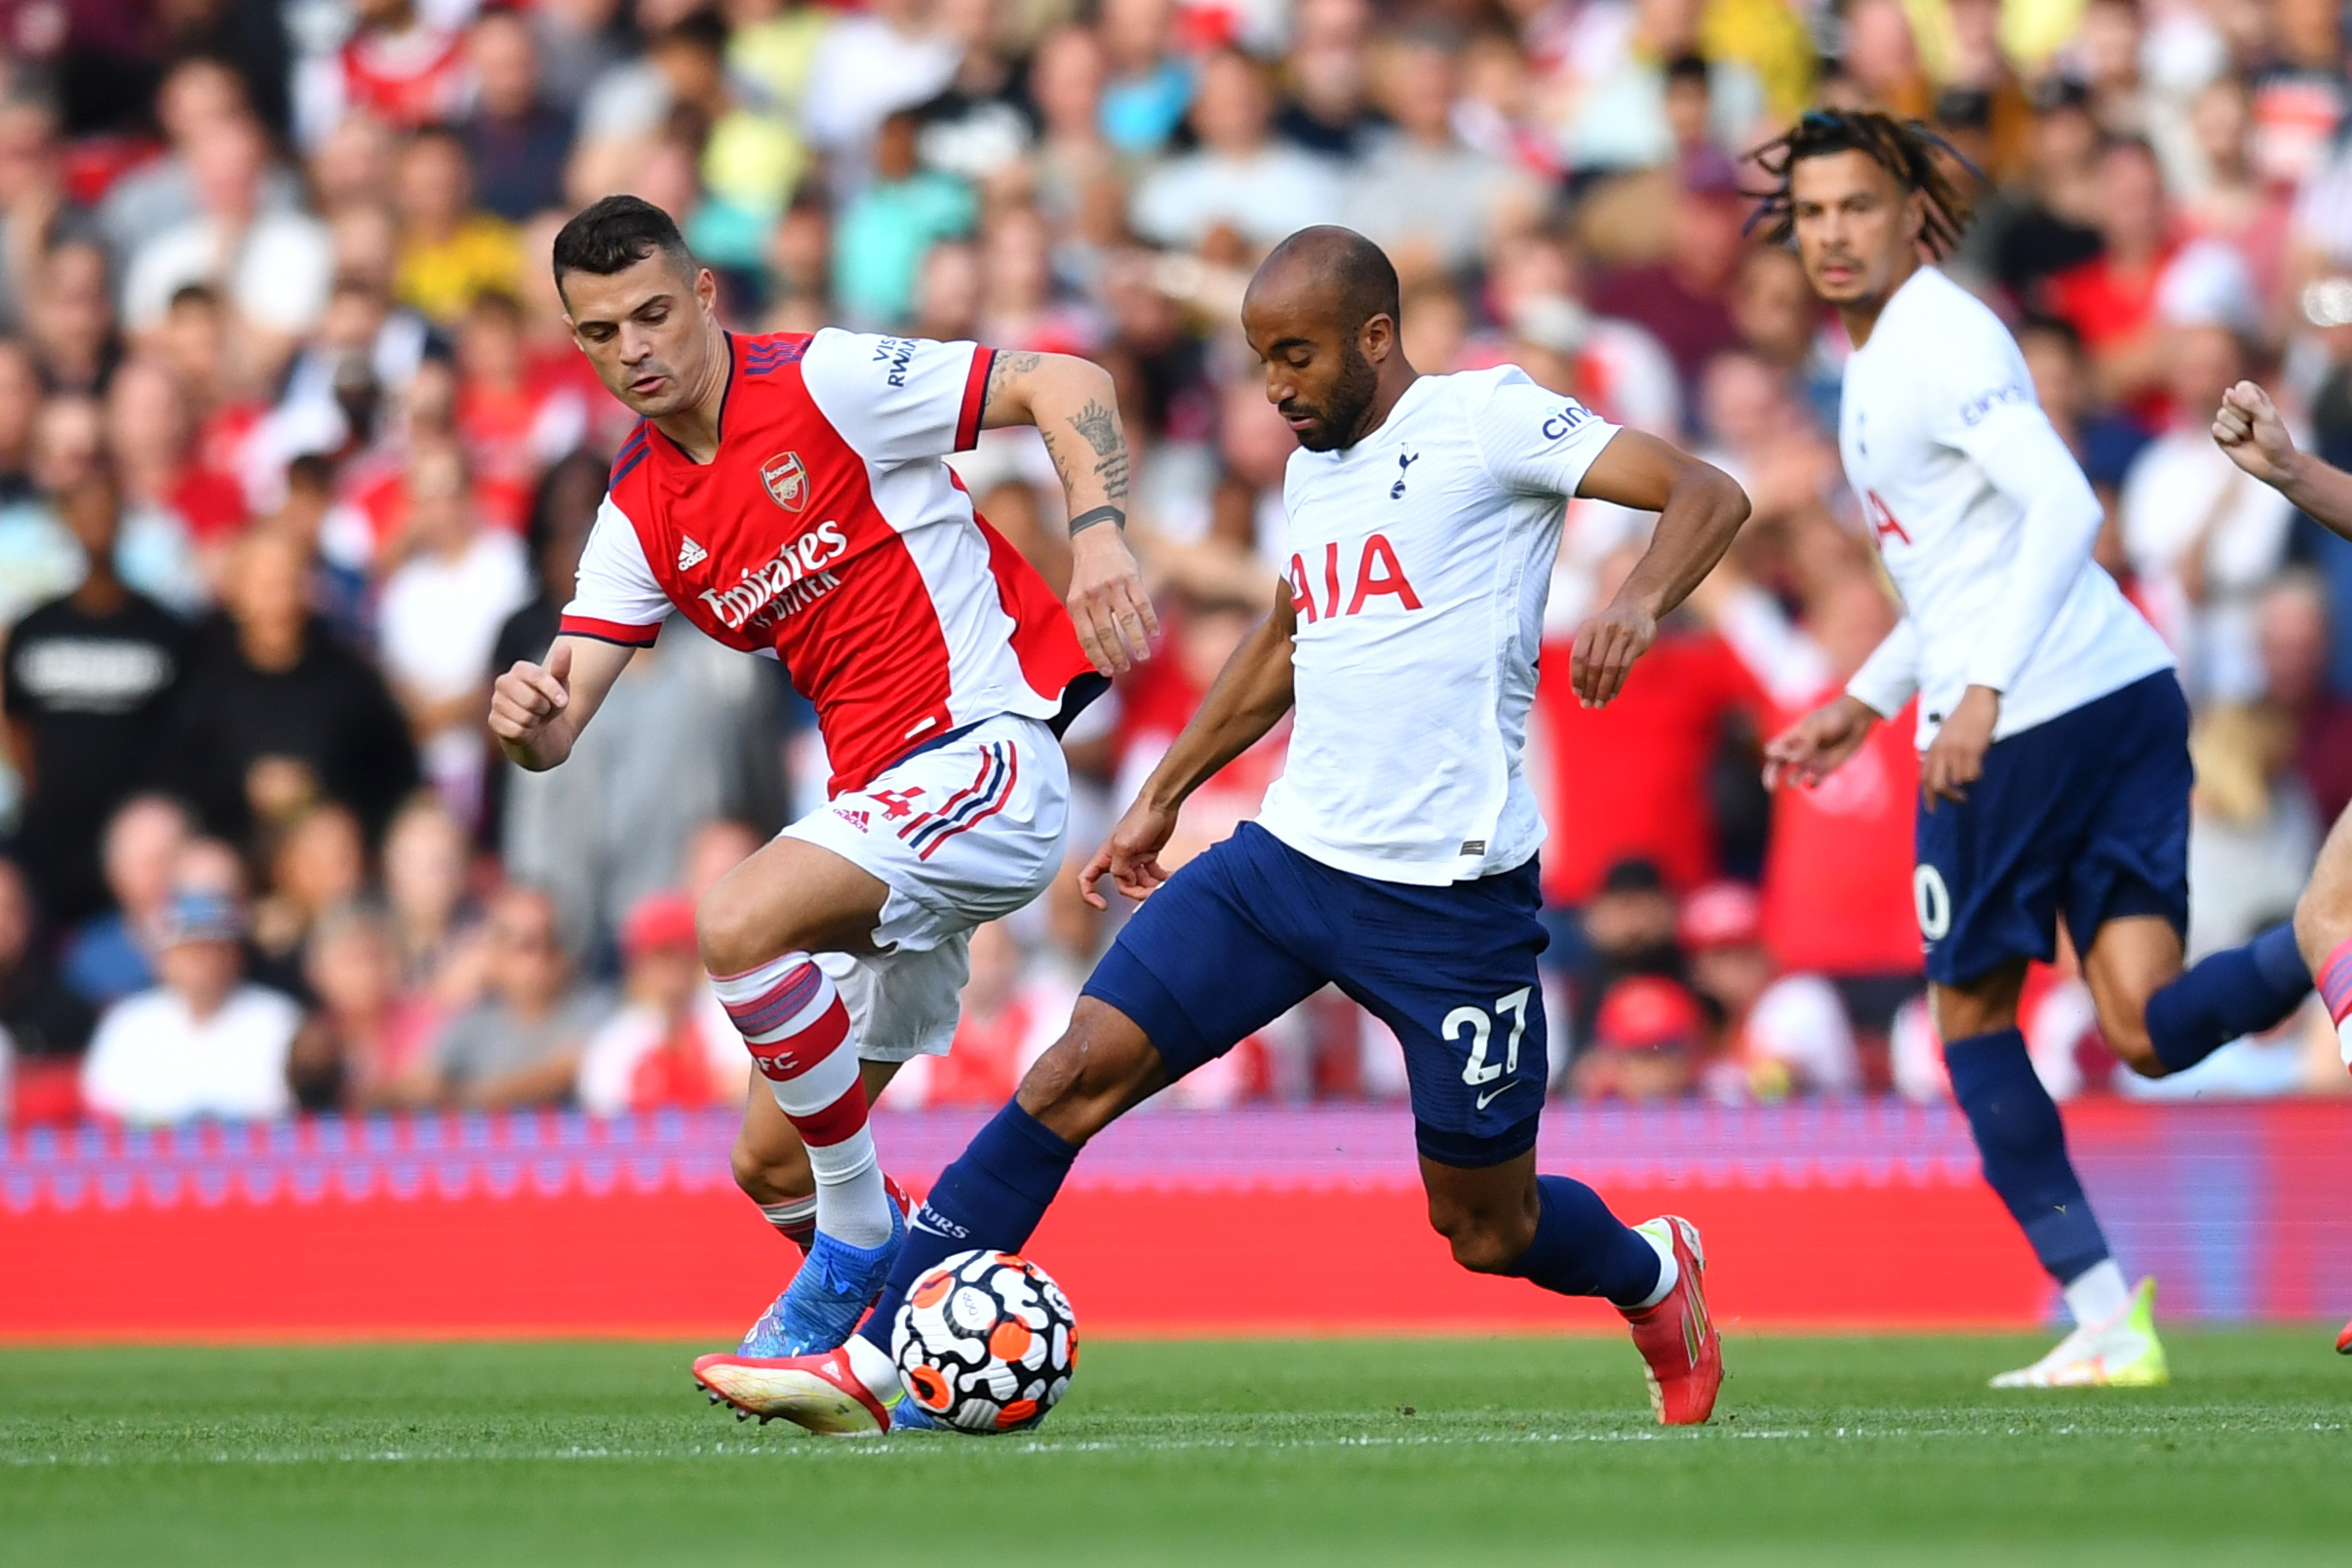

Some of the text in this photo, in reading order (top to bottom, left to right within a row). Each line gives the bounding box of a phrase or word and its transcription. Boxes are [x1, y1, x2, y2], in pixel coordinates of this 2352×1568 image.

[697, 521, 847, 628] Emirates
[1290, 533, 1424, 624] AIA
[833, 808, 869, 834] adidas
[1913, 863, 1951, 941] 0
[1441, 985, 1533, 1085] 27
